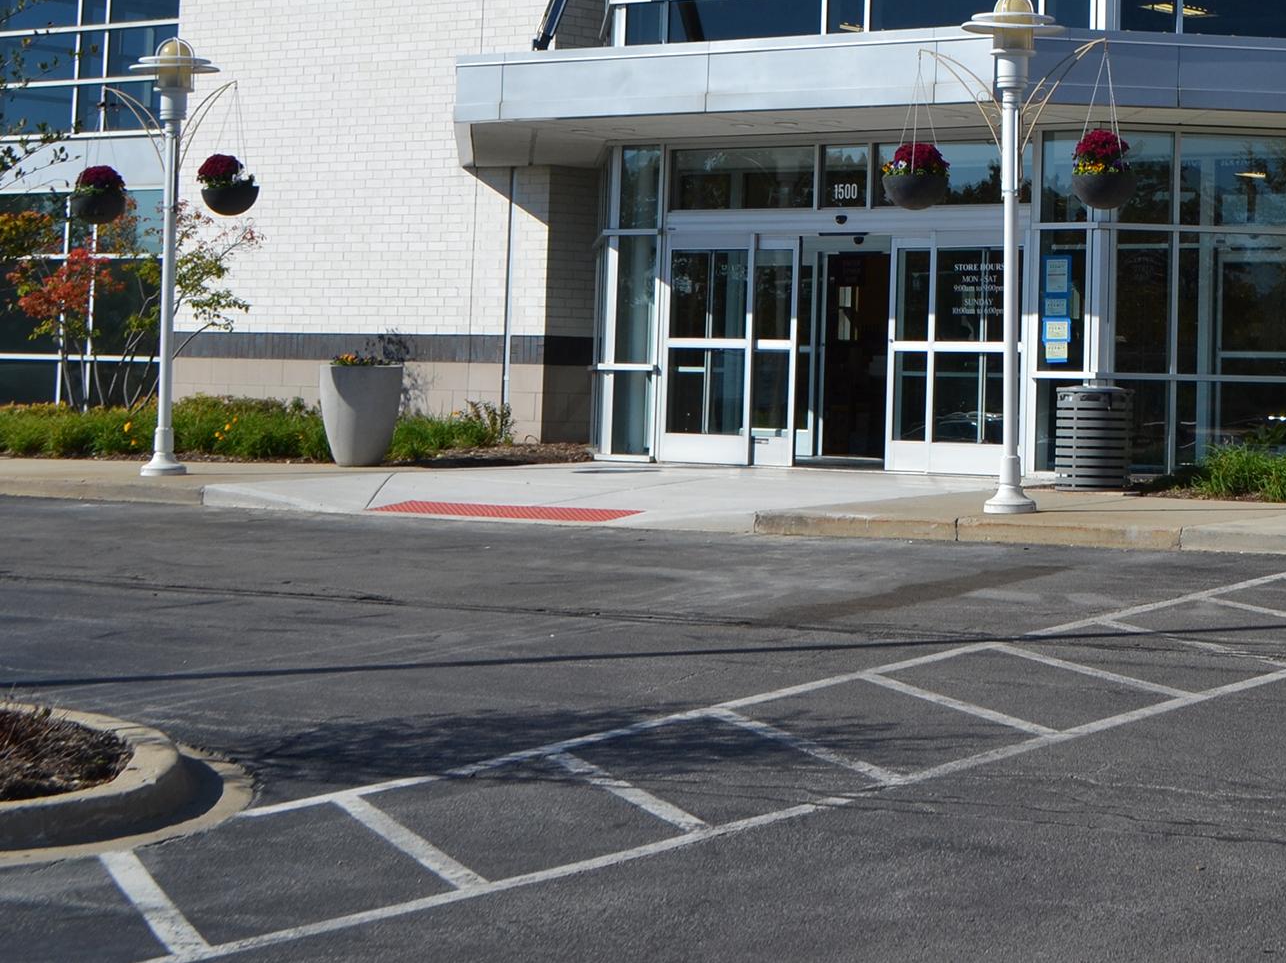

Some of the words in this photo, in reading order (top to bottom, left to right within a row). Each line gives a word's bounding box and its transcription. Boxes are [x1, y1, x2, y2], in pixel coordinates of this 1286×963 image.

[834, 183, 858, 200] 1500
[954, 263, 979, 271] STORE
[962, 275, 979, 283] MON
[964, 298, 993, 306] SUNDAY
